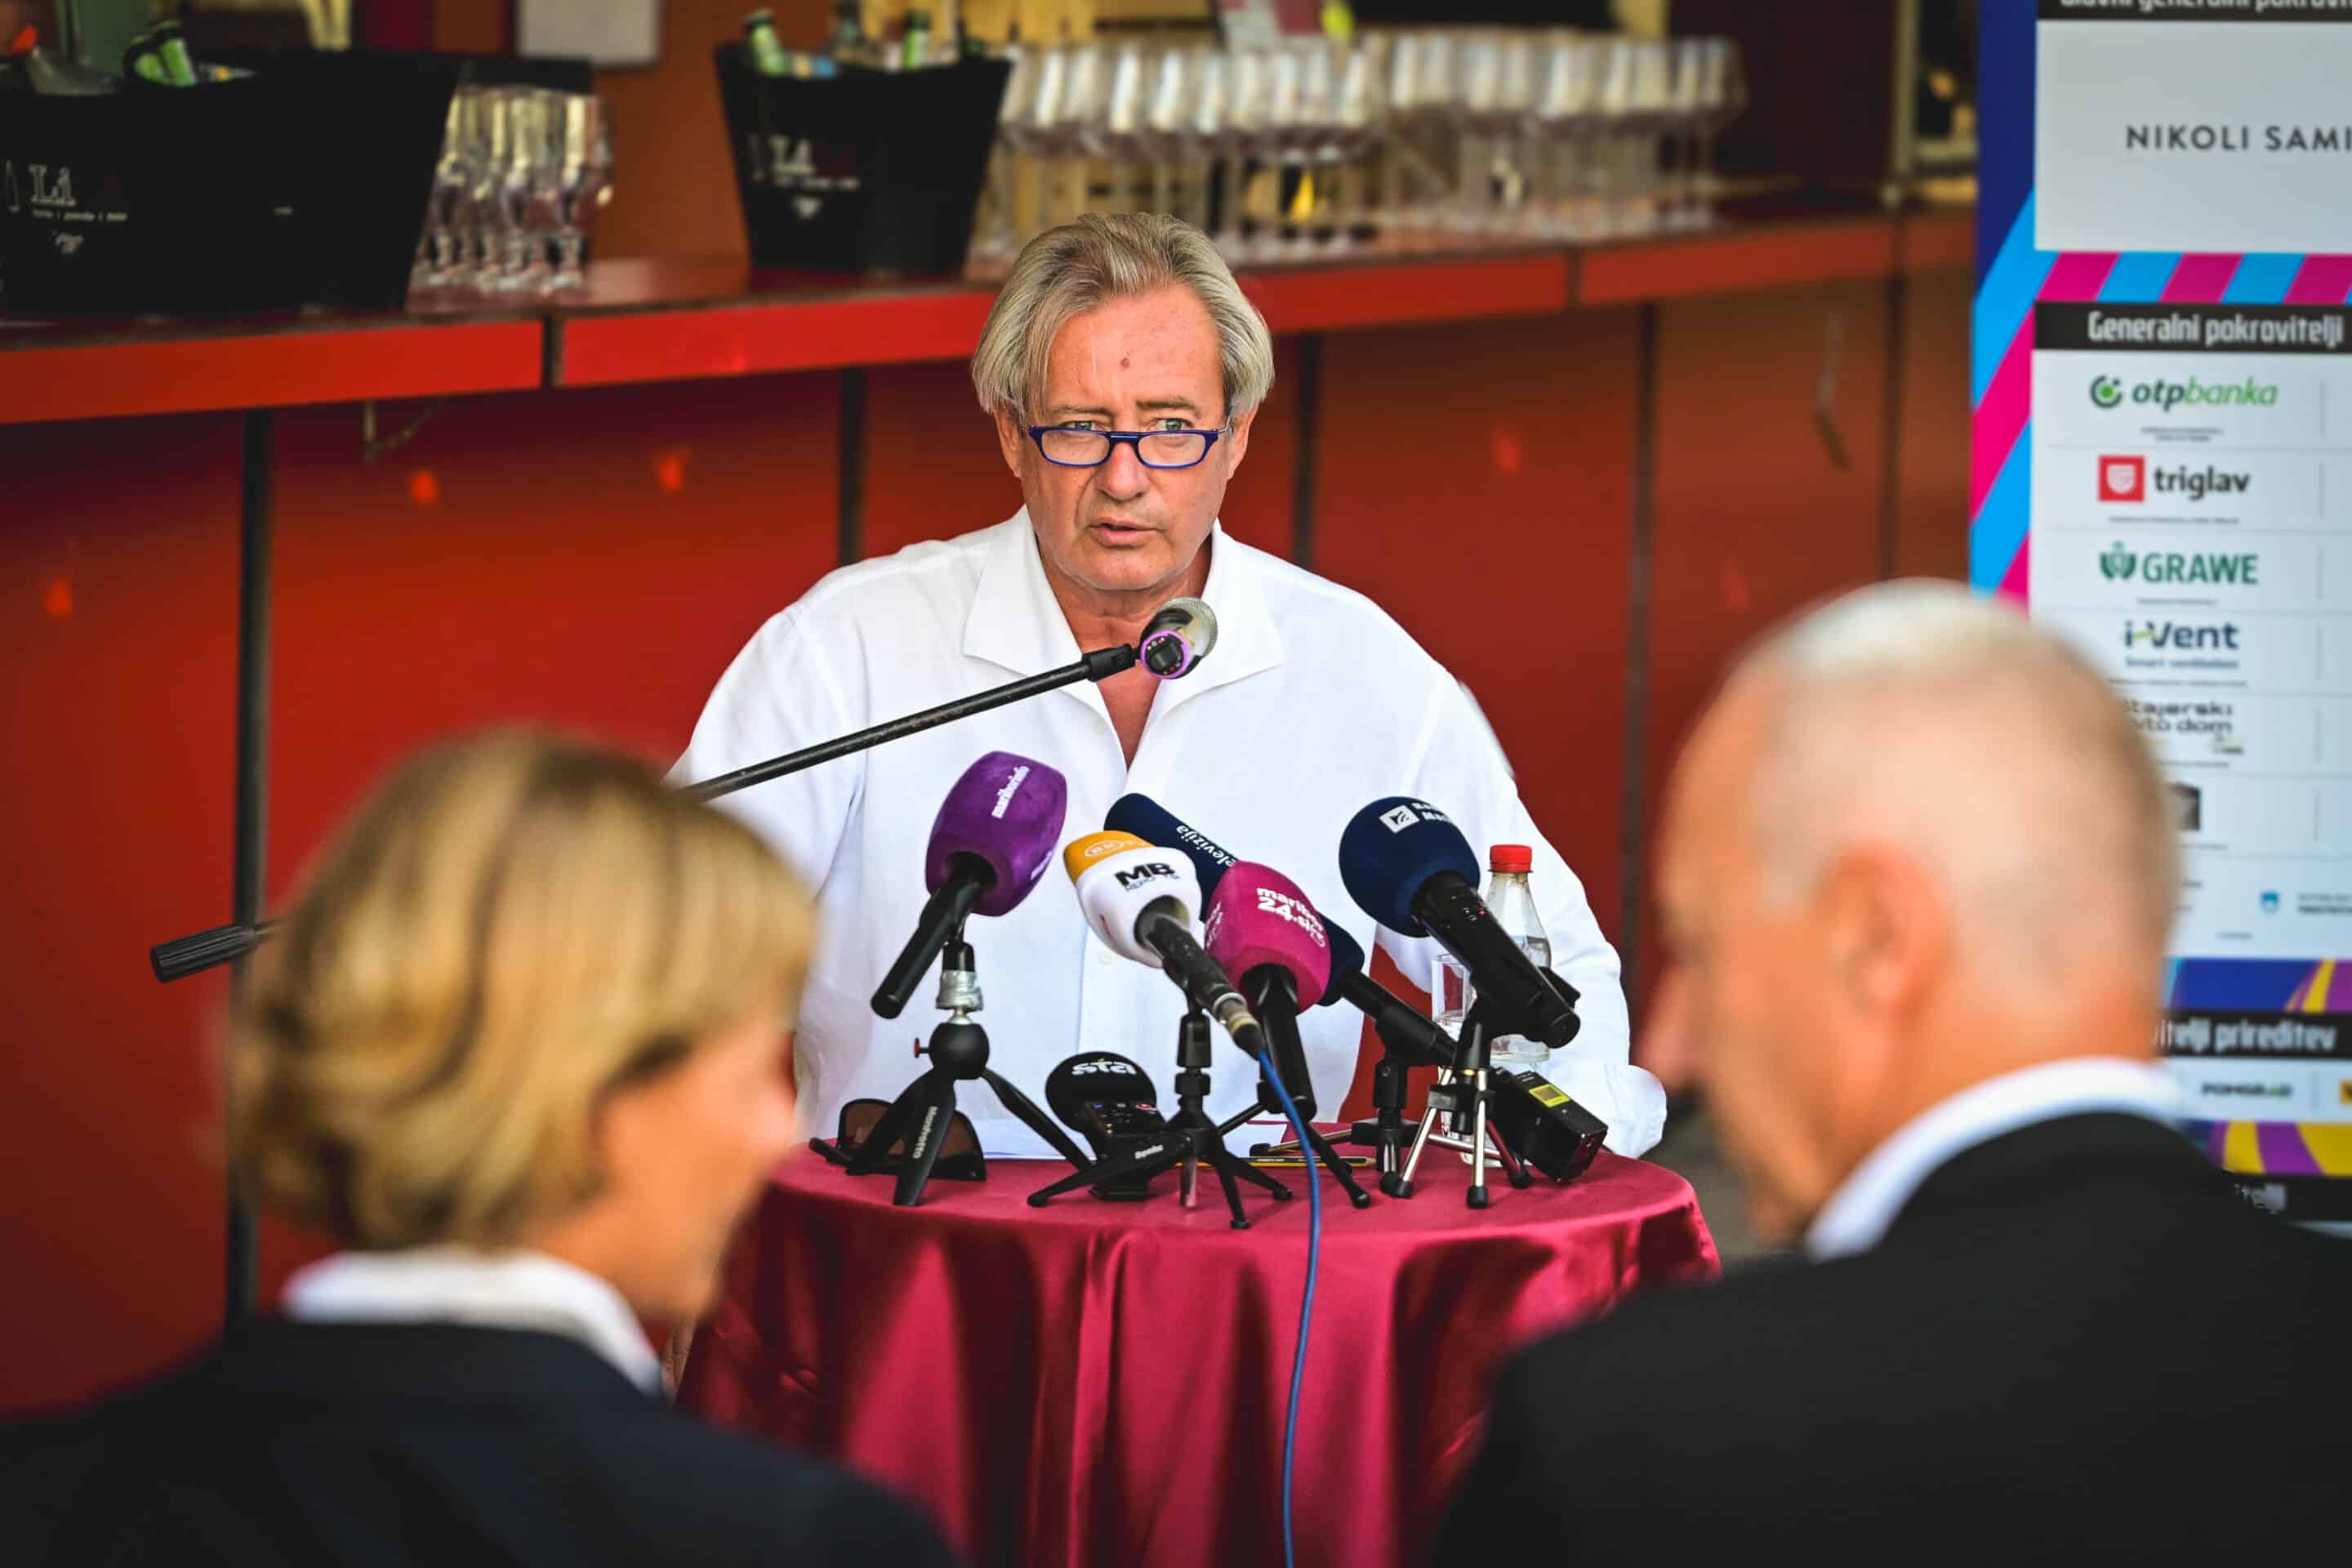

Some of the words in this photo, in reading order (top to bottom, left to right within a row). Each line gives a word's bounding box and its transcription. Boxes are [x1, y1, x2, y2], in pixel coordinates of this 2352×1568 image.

[2125, 125, 2249, 150] NIKOLI
[2087, 310, 2200, 341] Generalni
[2206, 314, 2345, 348] pokrovitelji
[2154, 464, 2251, 502] triglav
[2142, 552, 2259, 585] GRAWE
[1176, 824, 1237, 866] elevizija
[1114, 862, 1176, 887] MB
